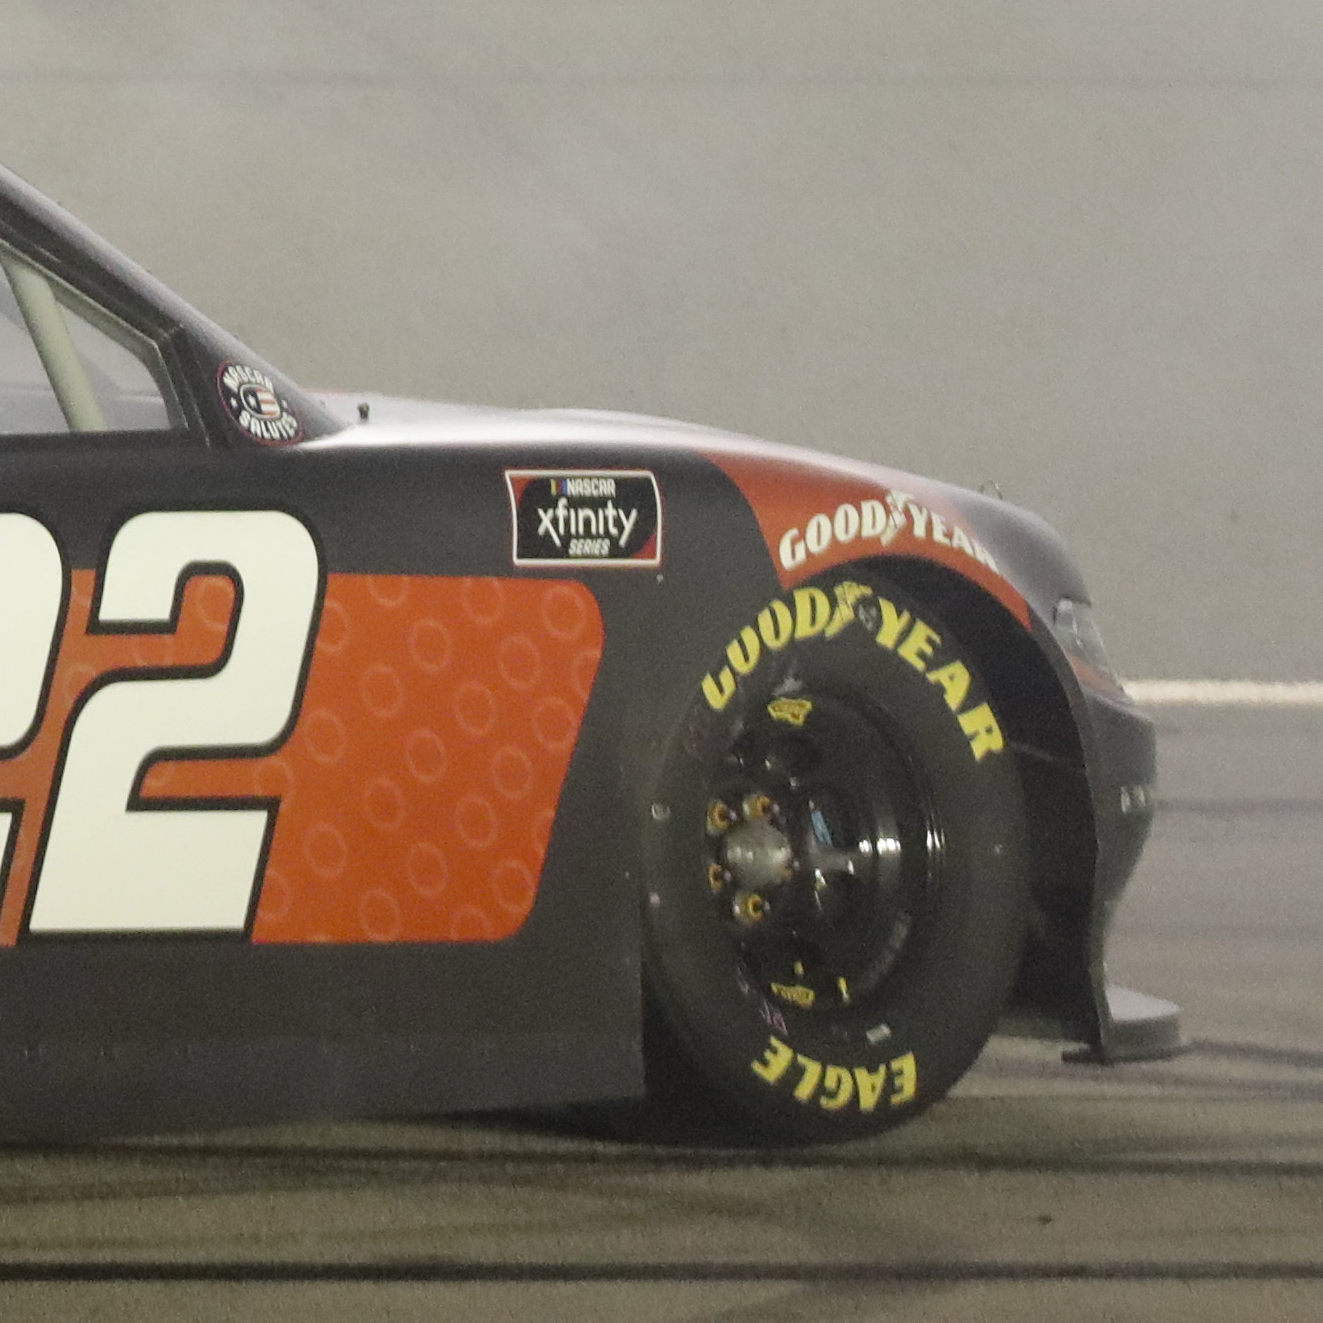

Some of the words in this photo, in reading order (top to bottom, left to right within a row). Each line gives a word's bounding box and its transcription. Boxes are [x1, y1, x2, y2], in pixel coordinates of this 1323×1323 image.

[565, 477, 617, 498] NASCAR
[537, 496, 639, 549] xfinity
[567, 537, 612, 557] SERIES
[778, 488, 1000, 572] GOODYEAR
[750, 1034, 918, 1113] EAGLE
